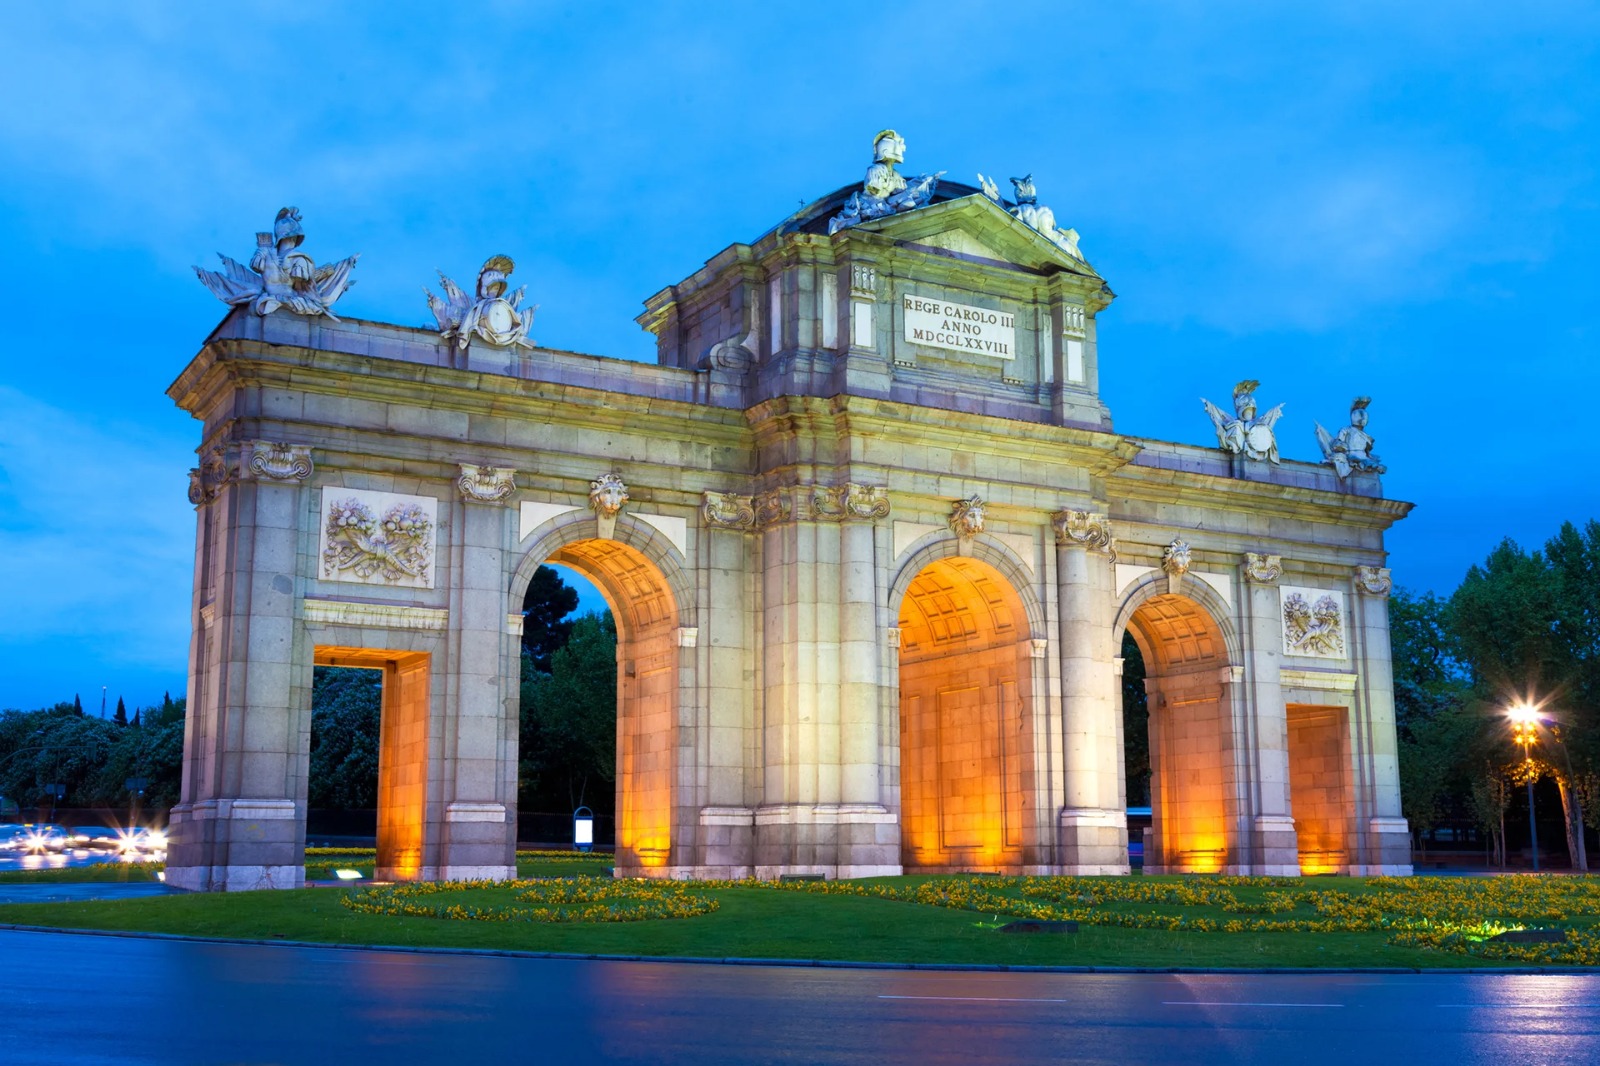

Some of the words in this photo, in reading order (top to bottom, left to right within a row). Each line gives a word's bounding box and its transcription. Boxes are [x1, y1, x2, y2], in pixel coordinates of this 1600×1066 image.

[904, 299, 940, 314] REGE
[944, 306, 997, 325] CAROLO
[1001, 316, 1014, 328] III
[941, 320, 981, 335] ANNO
[913, 328, 1008, 354] MDCCLXXVIII
